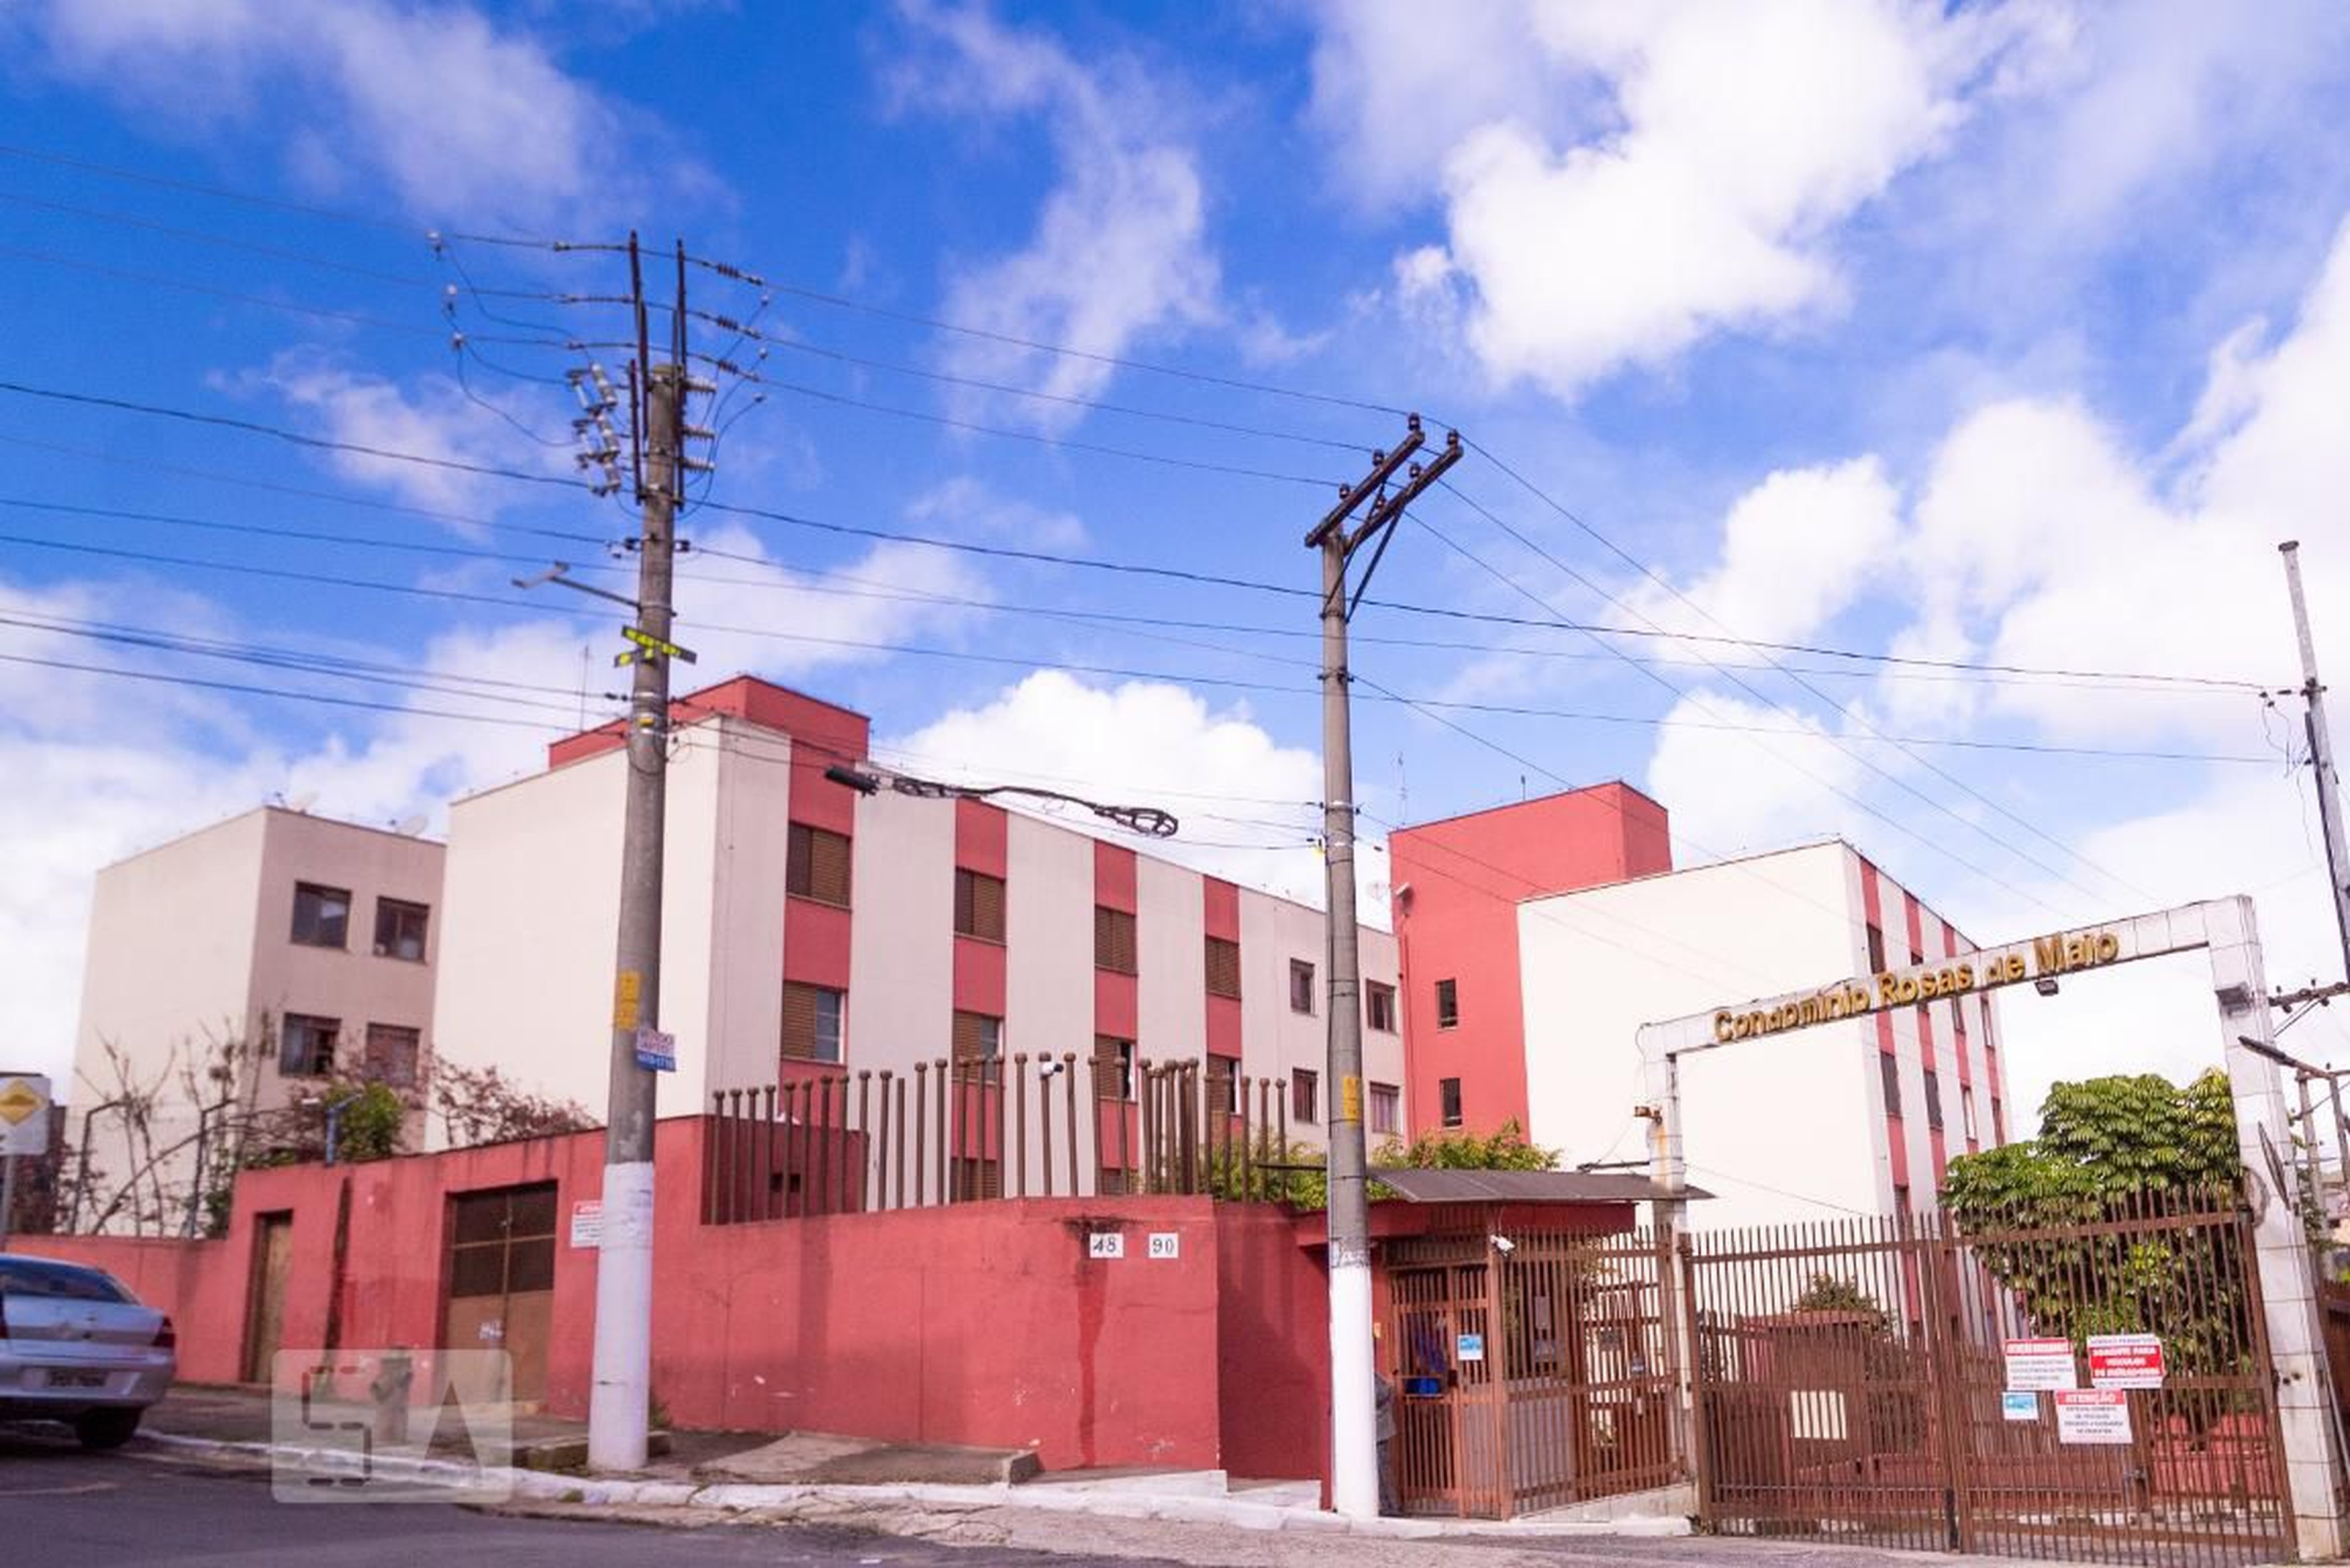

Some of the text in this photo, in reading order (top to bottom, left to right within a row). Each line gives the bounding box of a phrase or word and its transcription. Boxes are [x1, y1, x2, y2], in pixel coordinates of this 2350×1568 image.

[1876, 961, 1974, 1005] Rosas
[1985, 953, 2026, 984] de
[2033, 931, 2119, 975] Maio
[1094, 1237, 1116, 1252] 48
[1152, 1238, 1174, 1253] 90
